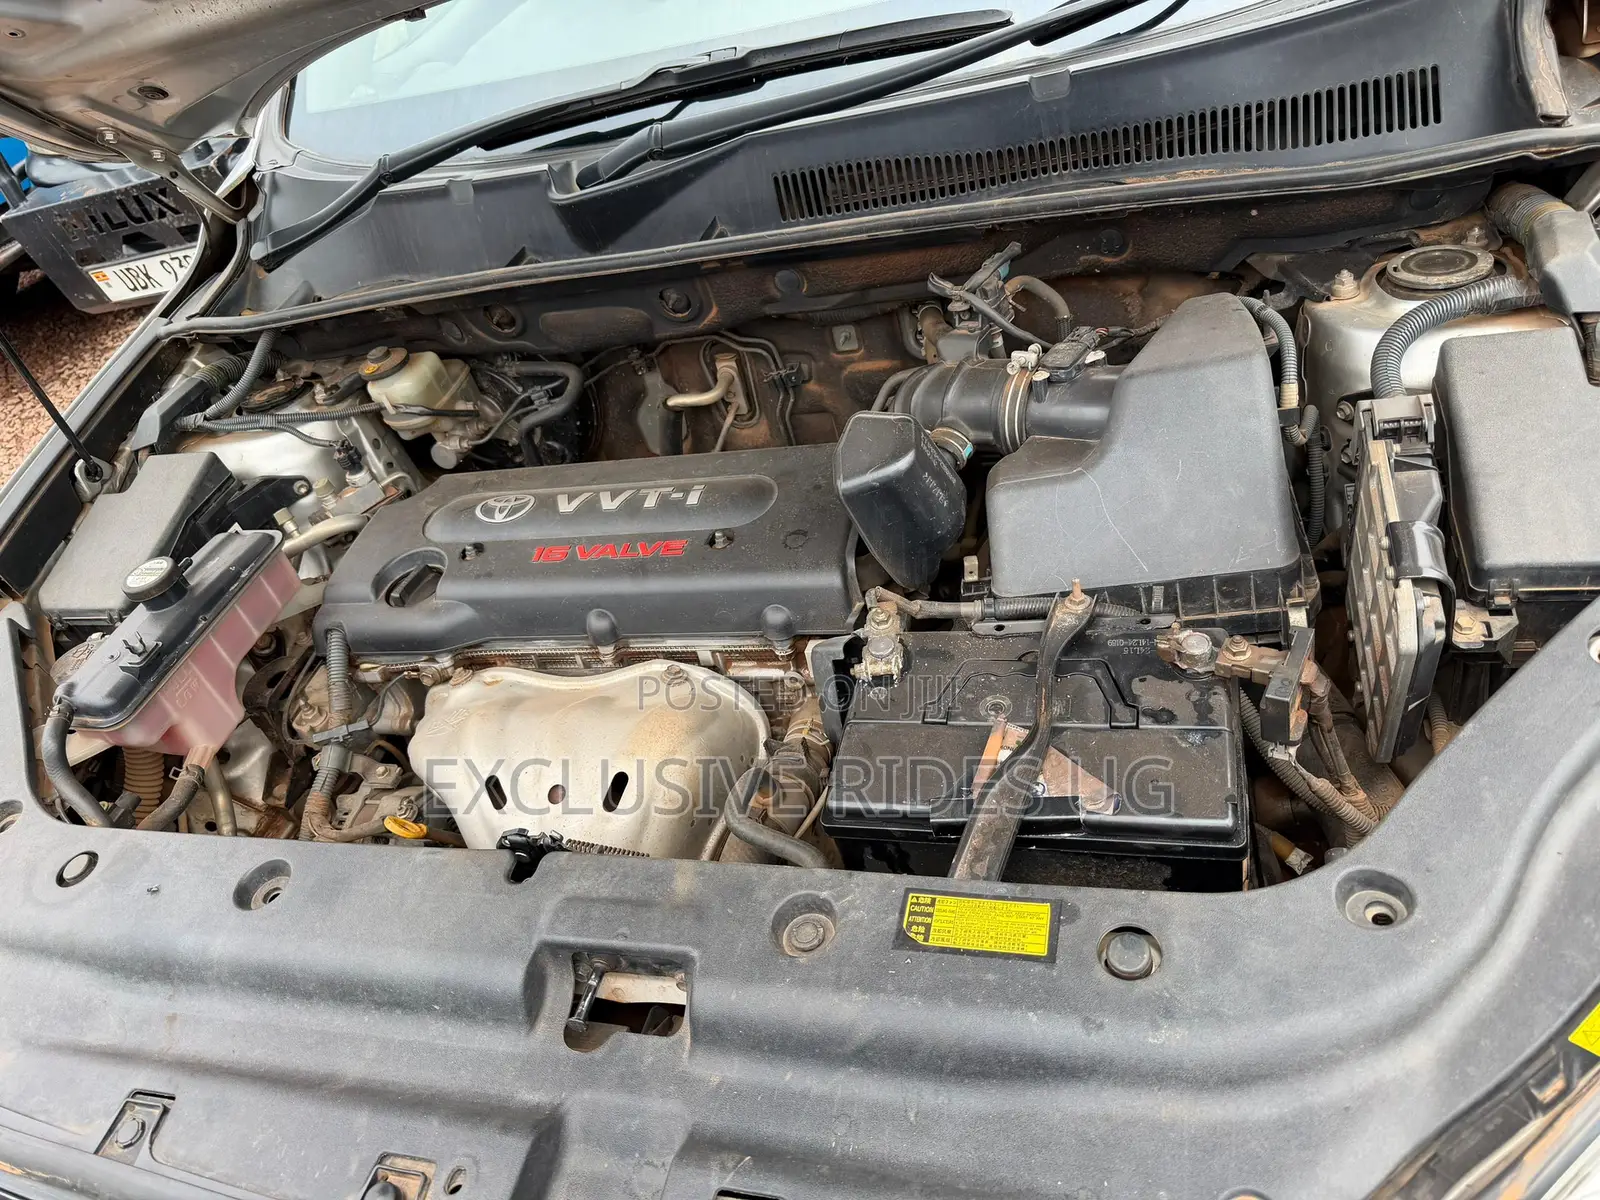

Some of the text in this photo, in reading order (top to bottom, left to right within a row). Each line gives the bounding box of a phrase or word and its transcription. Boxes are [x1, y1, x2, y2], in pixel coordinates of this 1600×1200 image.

[113, 264, 163, 292] UBK
[556, 484, 707, 515] VVT-i
[531, 539, 690, 563] 16 VALVE
[910, 905, 934, 913] CAUTION
